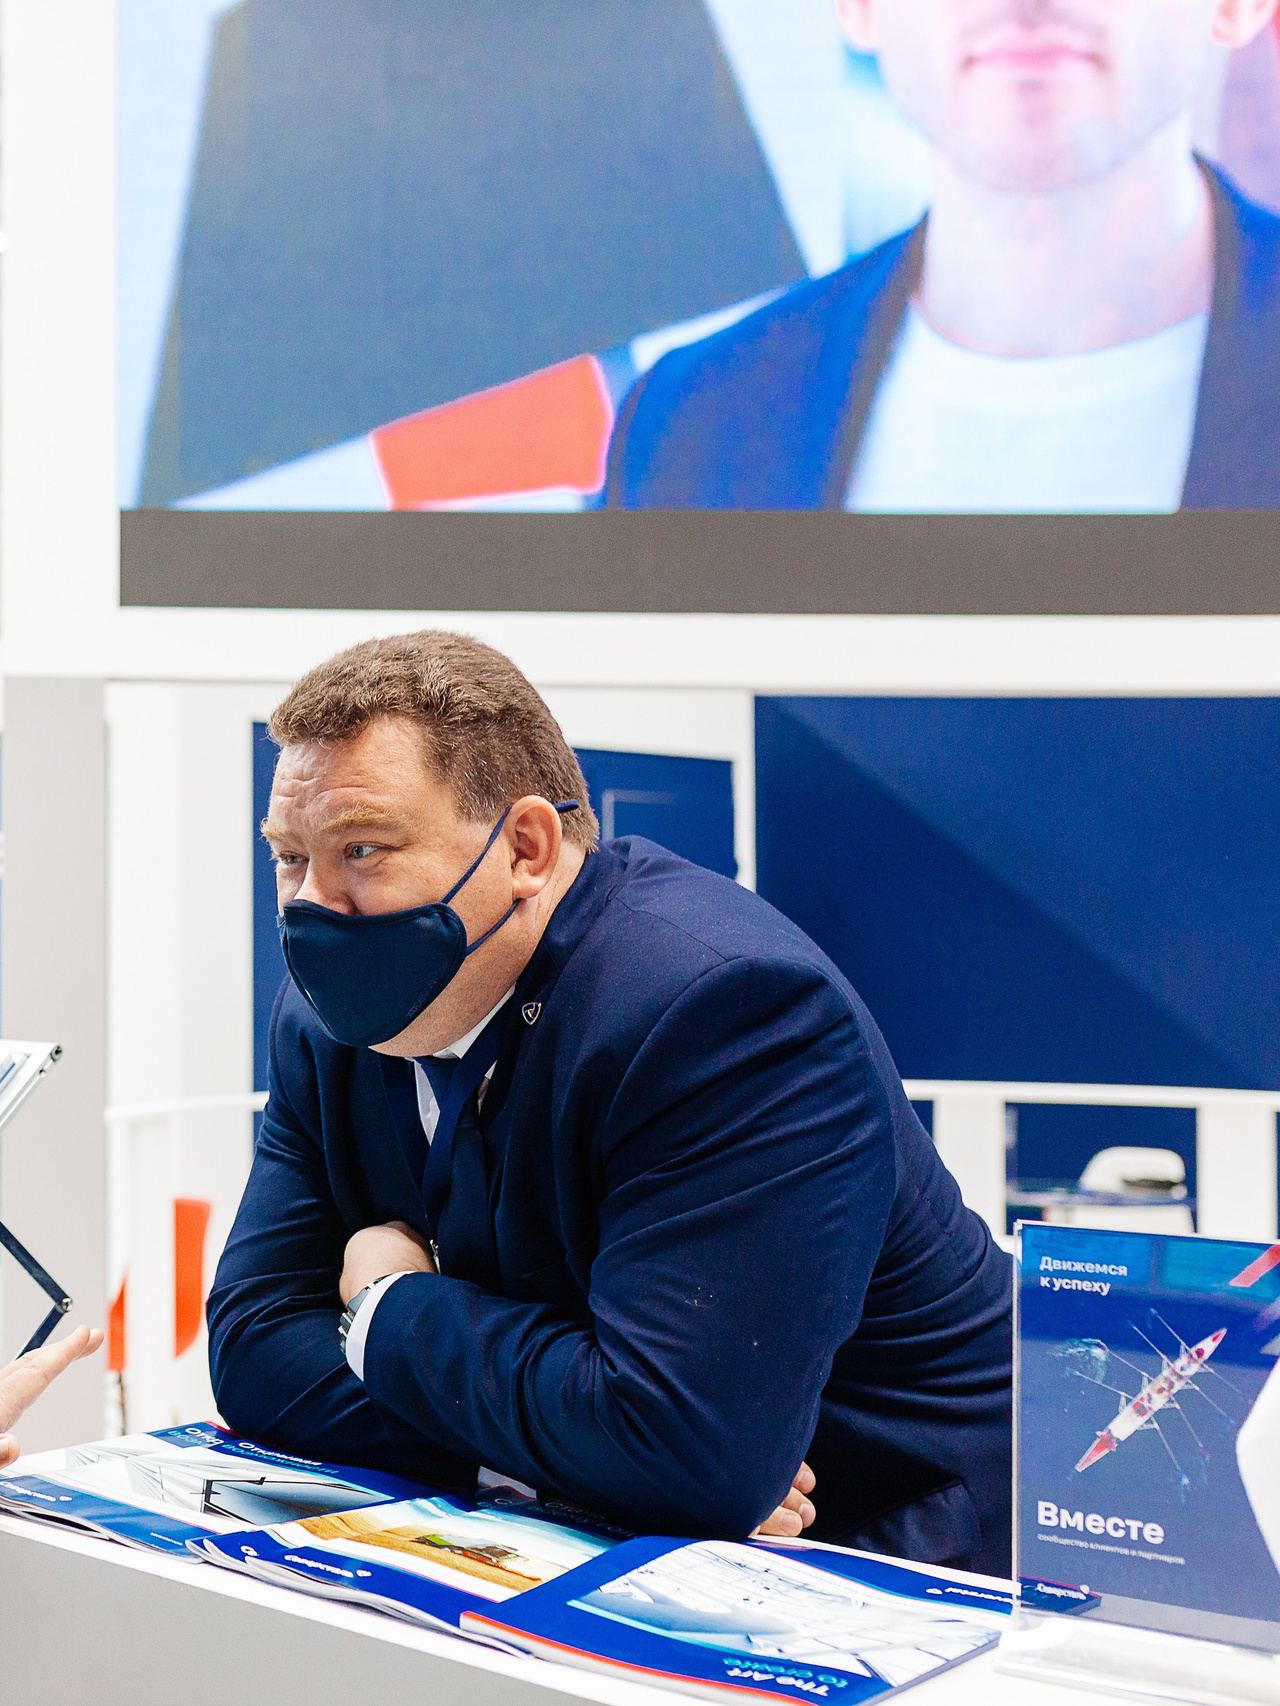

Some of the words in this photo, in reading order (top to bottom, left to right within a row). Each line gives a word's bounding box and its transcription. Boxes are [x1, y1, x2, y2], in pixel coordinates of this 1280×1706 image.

[1040, 1256, 1128, 1276] Движемся
[1040, 1276, 1051, 1288] к
[1052, 1277, 1111, 1296] успеху
[1037, 1501, 1165, 1545] Вместе
[1037, 1533, 1089, 1549] сообщество
[723, 1657, 813, 1679] create
[726, 1667, 775, 1682] Art
[775, 1675, 830, 1697] The
[817, 1673, 848, 1688] to
